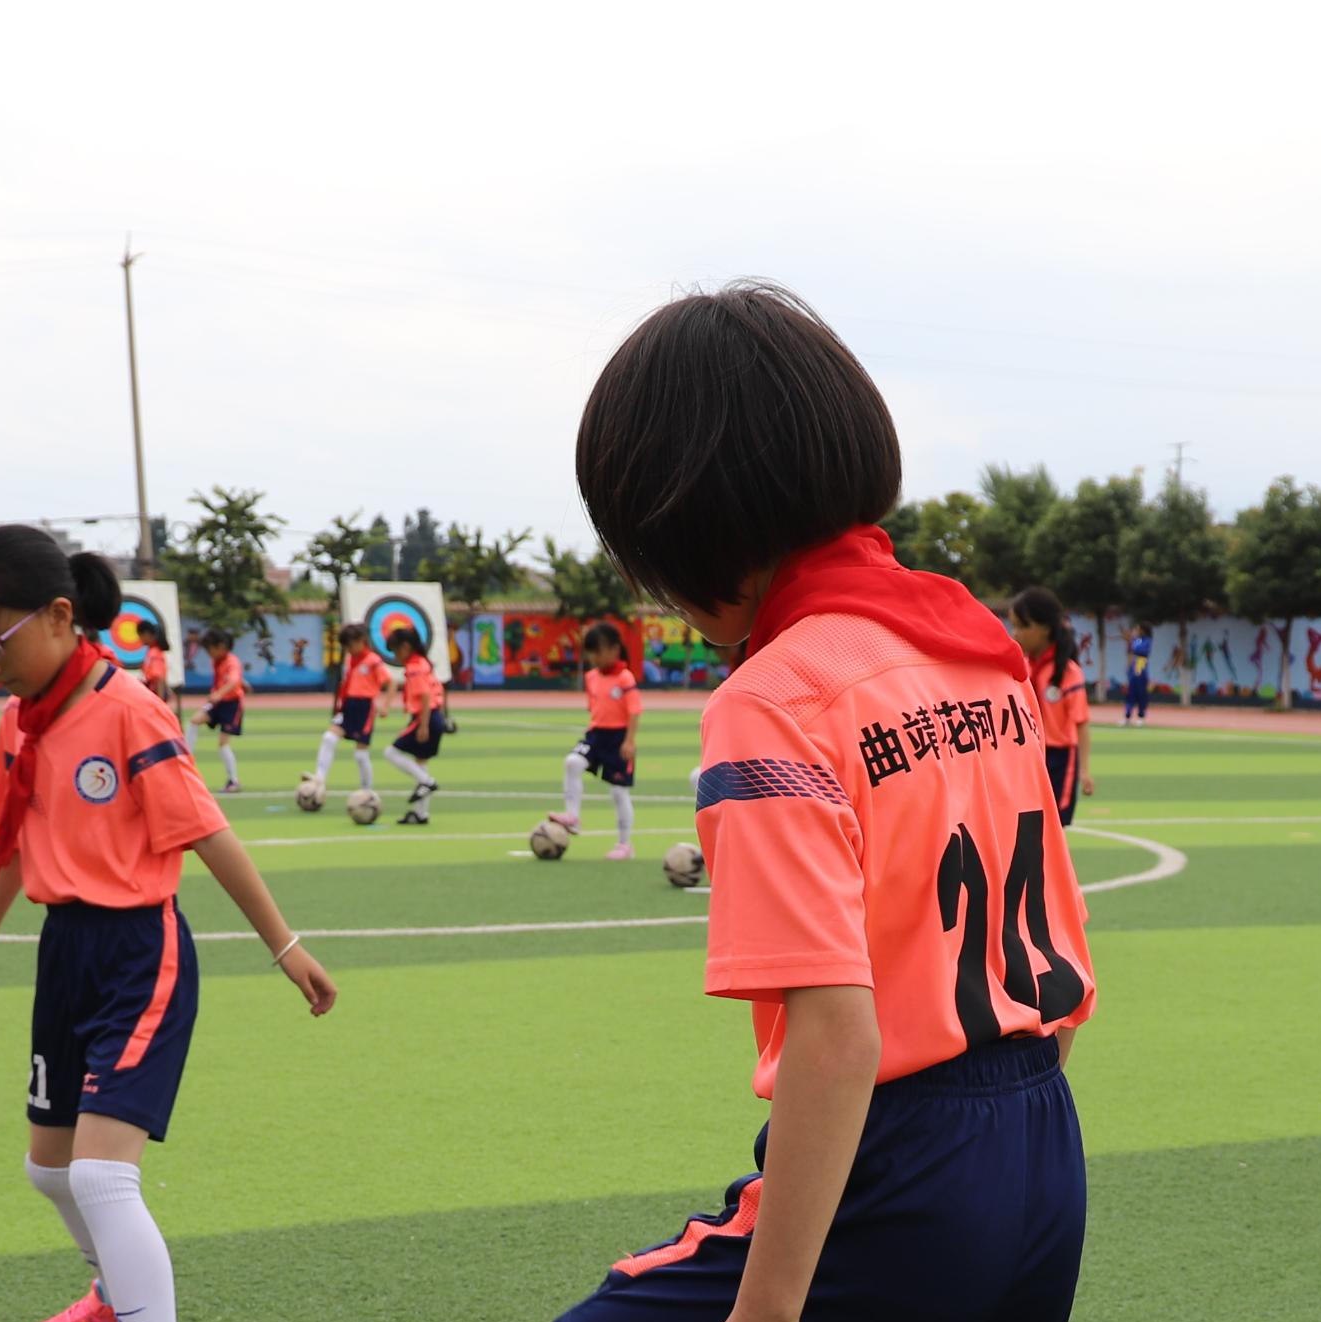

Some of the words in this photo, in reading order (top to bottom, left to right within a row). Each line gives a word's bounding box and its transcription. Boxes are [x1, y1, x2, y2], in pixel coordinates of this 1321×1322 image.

[859, 694, 1040, 788] 曲靖花柯小
[937, 810, 1085, 1051] 24
